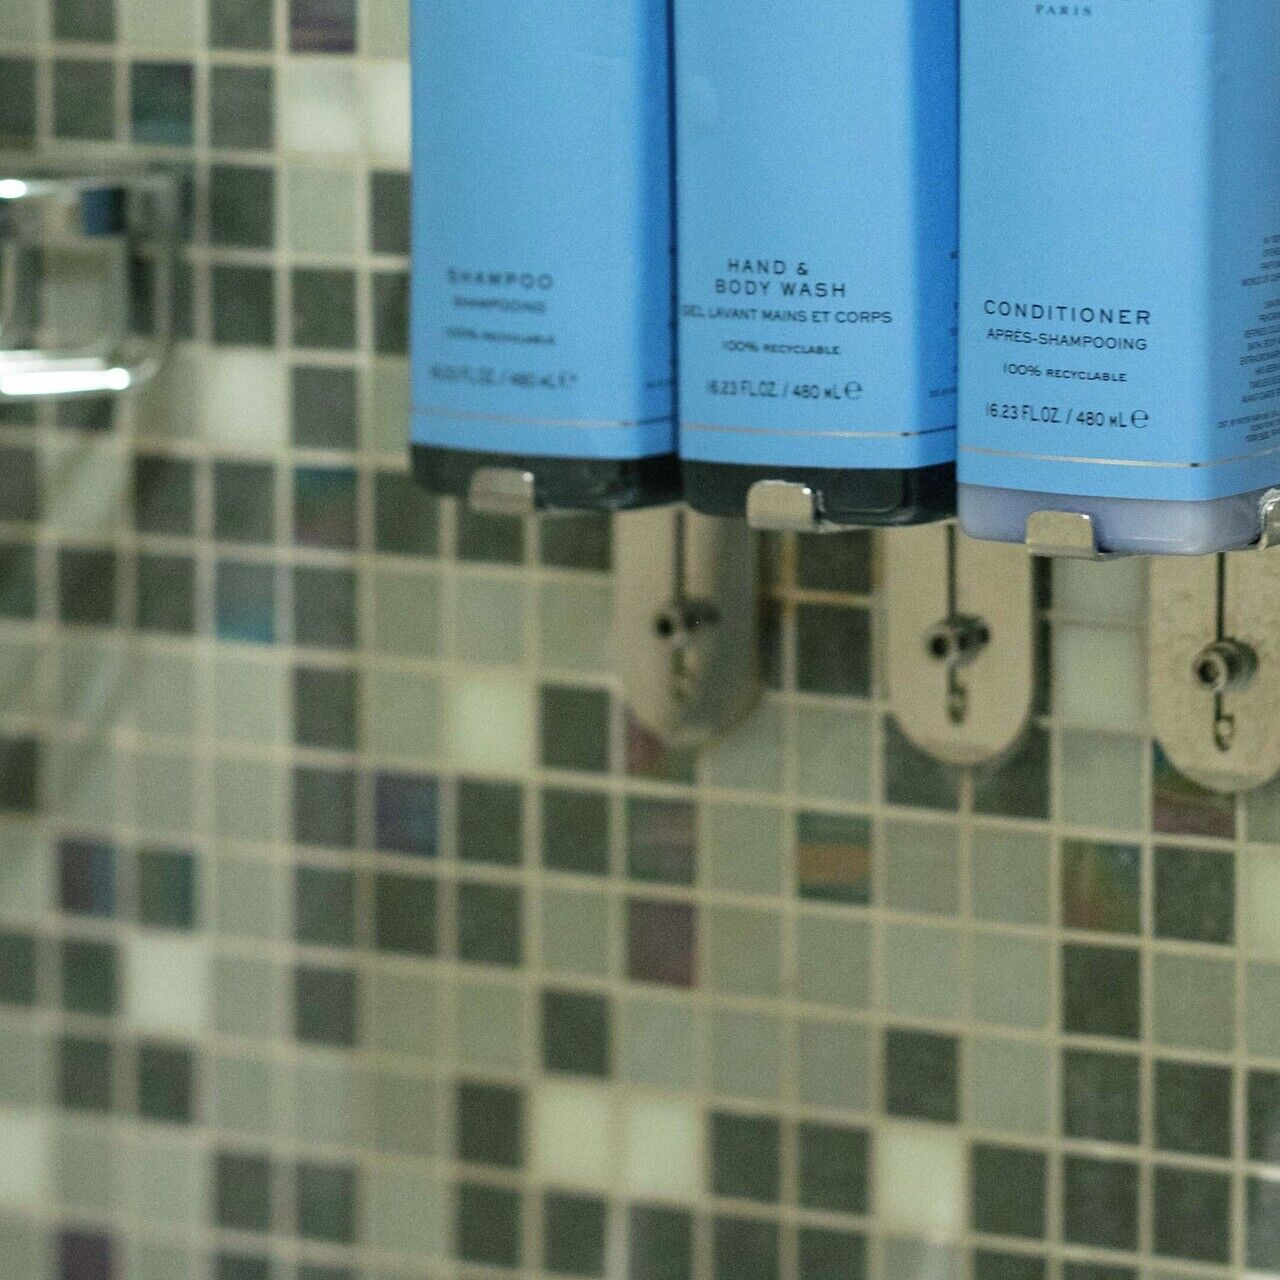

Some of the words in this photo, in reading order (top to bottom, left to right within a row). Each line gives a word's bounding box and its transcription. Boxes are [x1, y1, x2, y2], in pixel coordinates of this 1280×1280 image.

[1035, 4, 1093, 17] PARIS
[727, 258, 787, 276] HAND
[796, 262, 809, 276] &
[714, 278, 771, 296] BODY
[780, 282, 847, 298] WASH
[760, 309, 808, 322] MAINS
[811, 311, 830, 323] ET
[833, 311, 893, 324] CORPS
[983, 299, 1151, 326] CONDITIONER
[986, 326, 1148, 351] APRÈS-SHAMPOOING
[1002, 362, 1042, 377] 100%
[1045, 368, 1128, 382] RECYCLABLE
[1076, 410, 1106, 427] 480
